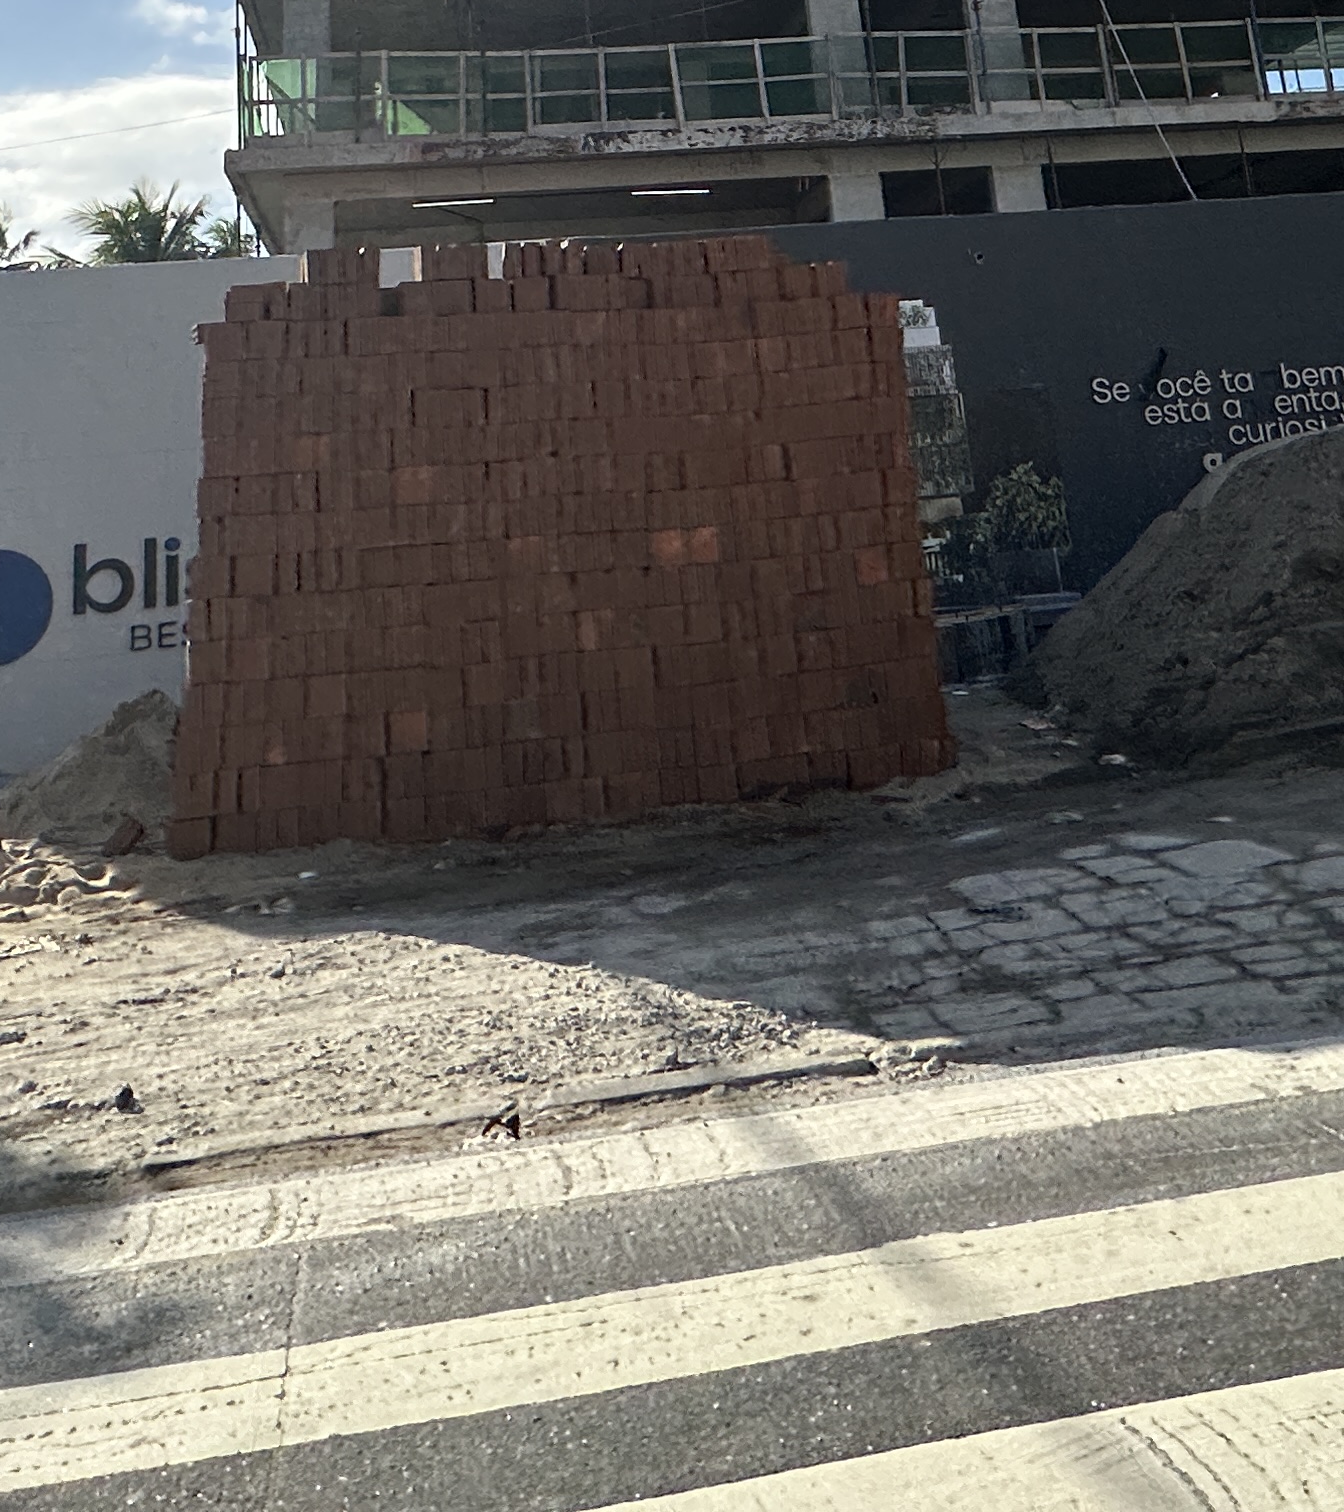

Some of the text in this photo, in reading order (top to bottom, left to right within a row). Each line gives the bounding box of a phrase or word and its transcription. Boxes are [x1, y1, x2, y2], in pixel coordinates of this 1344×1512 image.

[1091, 377, 1131, 404] Se
[72, 536, 189, 616] bli
[130, 620, 188, 652] BE
